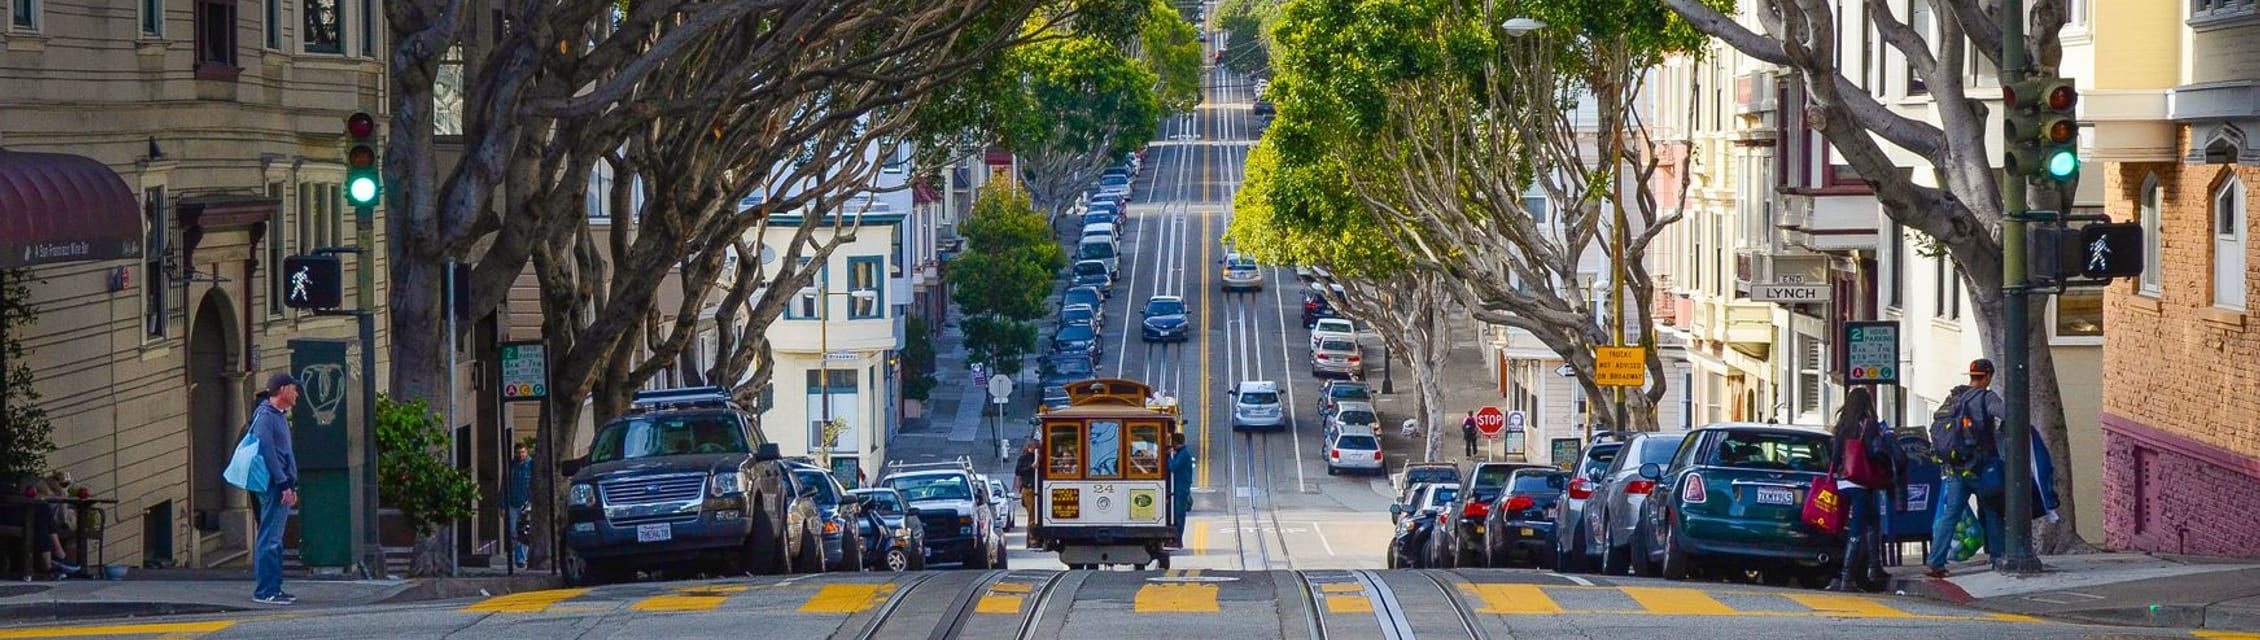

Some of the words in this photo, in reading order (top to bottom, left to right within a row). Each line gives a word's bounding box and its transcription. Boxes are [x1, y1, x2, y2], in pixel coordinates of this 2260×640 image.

[1766, 287, 1816, 299] LYNCH
[1851, 328, 1862, 340] 2
[506, 347, 514, 359] 2
[1854, 368, 1862, 377] A
[507, 385, 516, 394] A
[1478, 414, 1502, 426] STOP
[1093, 484, 1115, 494] 24
